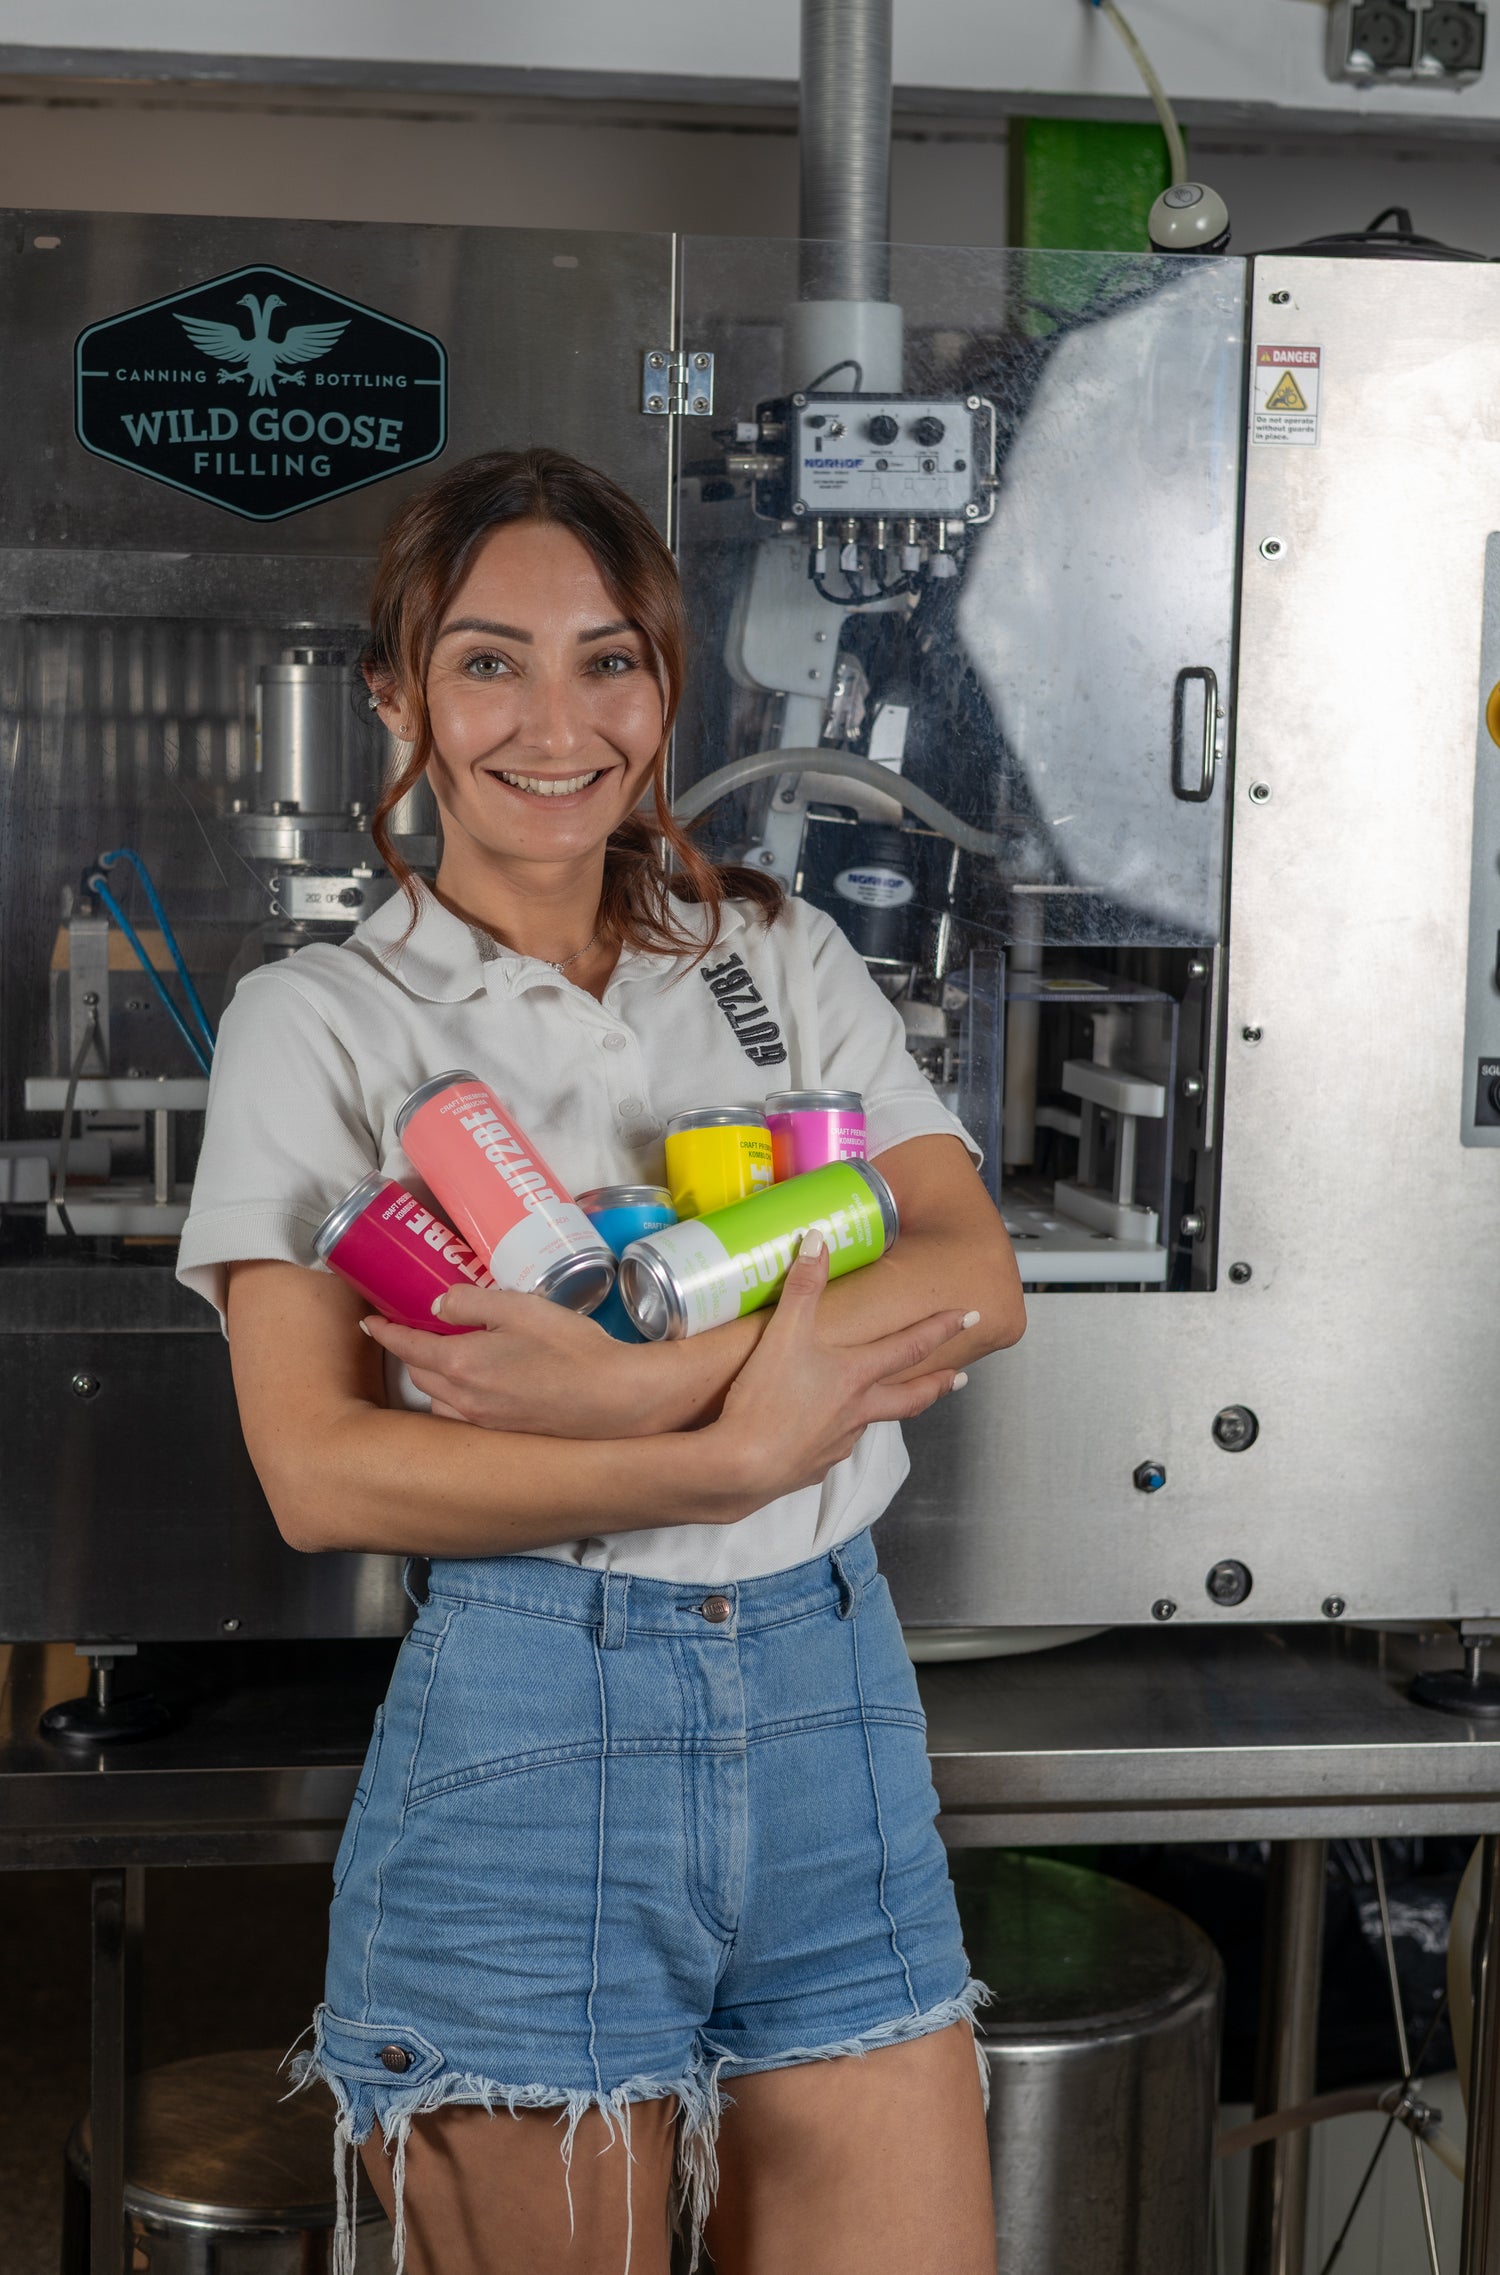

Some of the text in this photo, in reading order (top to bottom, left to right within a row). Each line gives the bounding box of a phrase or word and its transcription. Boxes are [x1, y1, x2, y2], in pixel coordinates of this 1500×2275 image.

[1273, 351, 1317, 363] DANGER
[115, 368, 408, 388] CANNING BOTTLING
[120, 408, 404, 453] WILD GOOSE
[194, 453, 331, 477] FILLING
[440, 1098, 460, 1114] CRAFT
[452, 1099, 488, 1116] KOMBUCHA
[831, 1127, 850, 1137] CRAFT
[740, 1141, 758, 1150] CRAFT
[459, 1107, 561, 1213] GUT2BE
[382, 1202, 399, 1220] CRAFT
[851, 1192, 866, 1213] CRAFT
[643, 1221, 663, 1230] CRAFT
